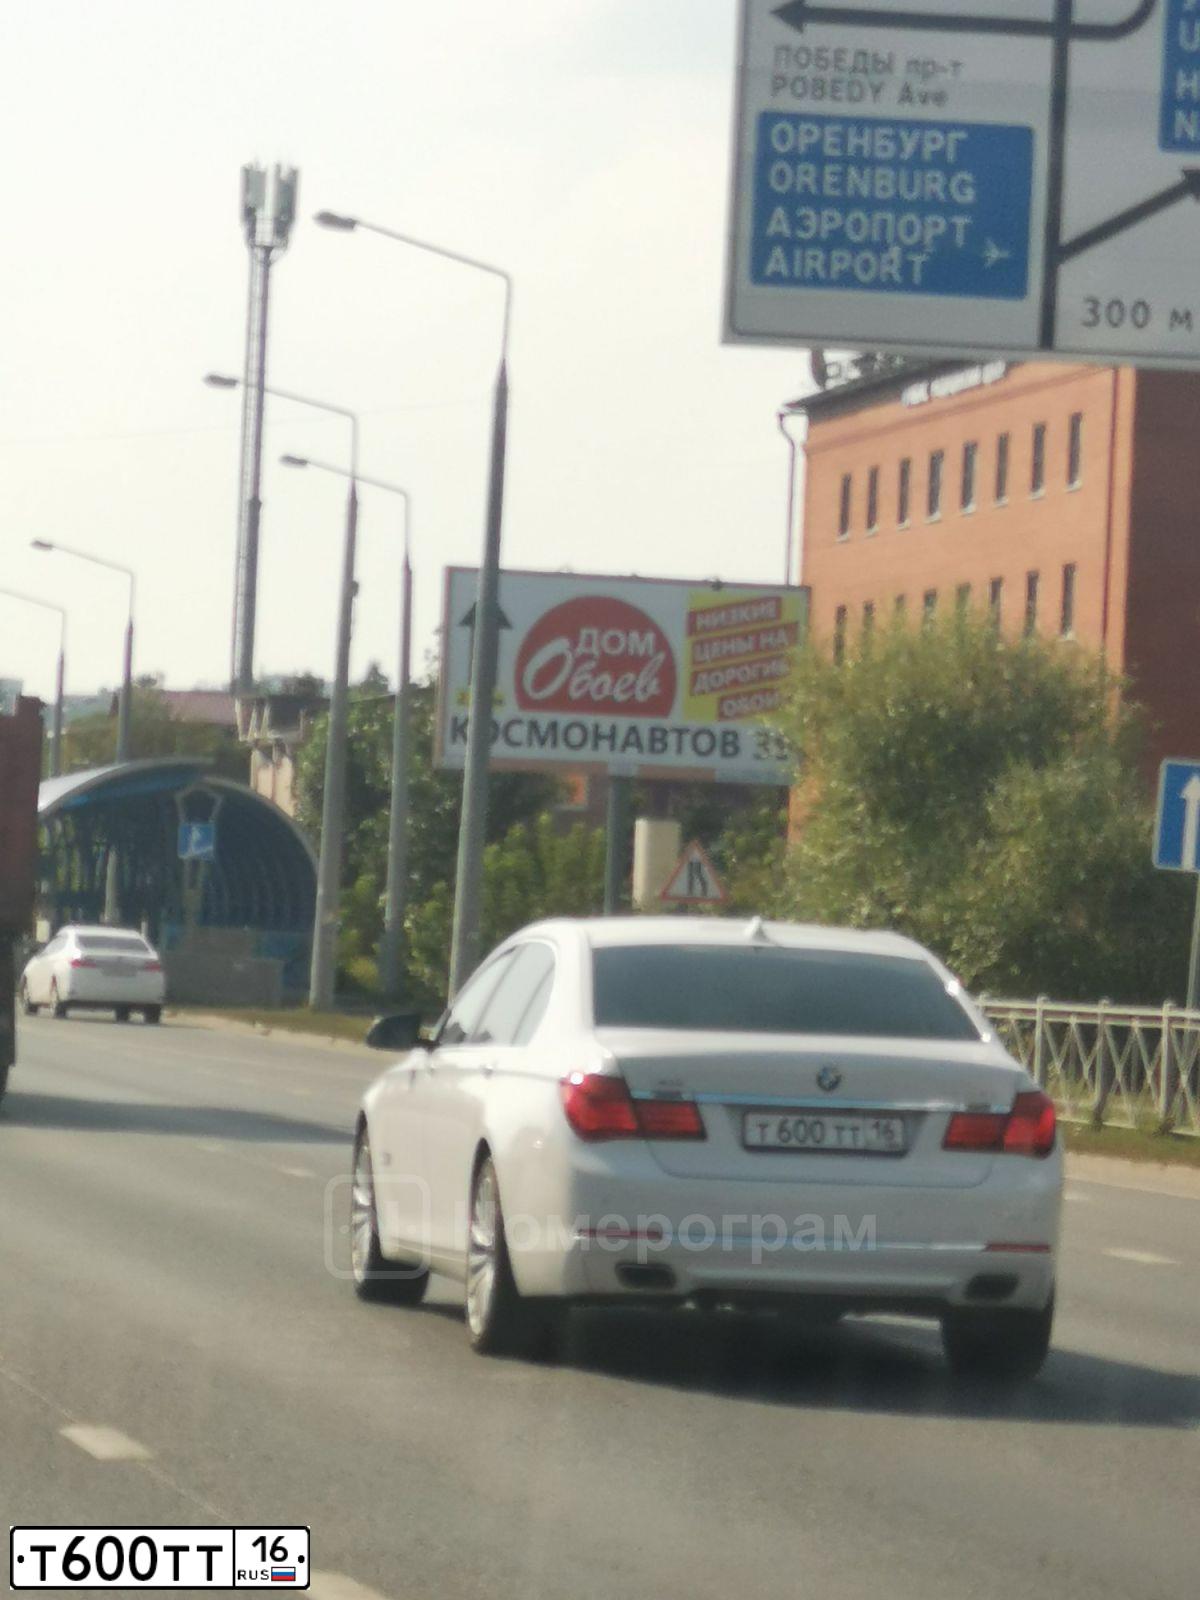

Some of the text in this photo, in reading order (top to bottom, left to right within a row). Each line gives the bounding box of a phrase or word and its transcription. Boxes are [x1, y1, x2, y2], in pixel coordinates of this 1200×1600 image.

[773, 45, 963, 80] ПОБЕДЫ пр-т
[771, 73, 948, 106] POBEDY Ave
[771, 121, 968, 164] ОРЕНБУРГ
[769, 160, 976, 204] ORENBURG
[766, 206, 973, 250] АЭРОПОРТ
[764, 246, 930, 286] AIRPORT
[1081, 295, 1152, 329] 300
[574, 627, 657, 658] ДОМ
[694, 628, 789, 663] ЦЕНЫ НА
[522, 637, 667, 704] Обоев
